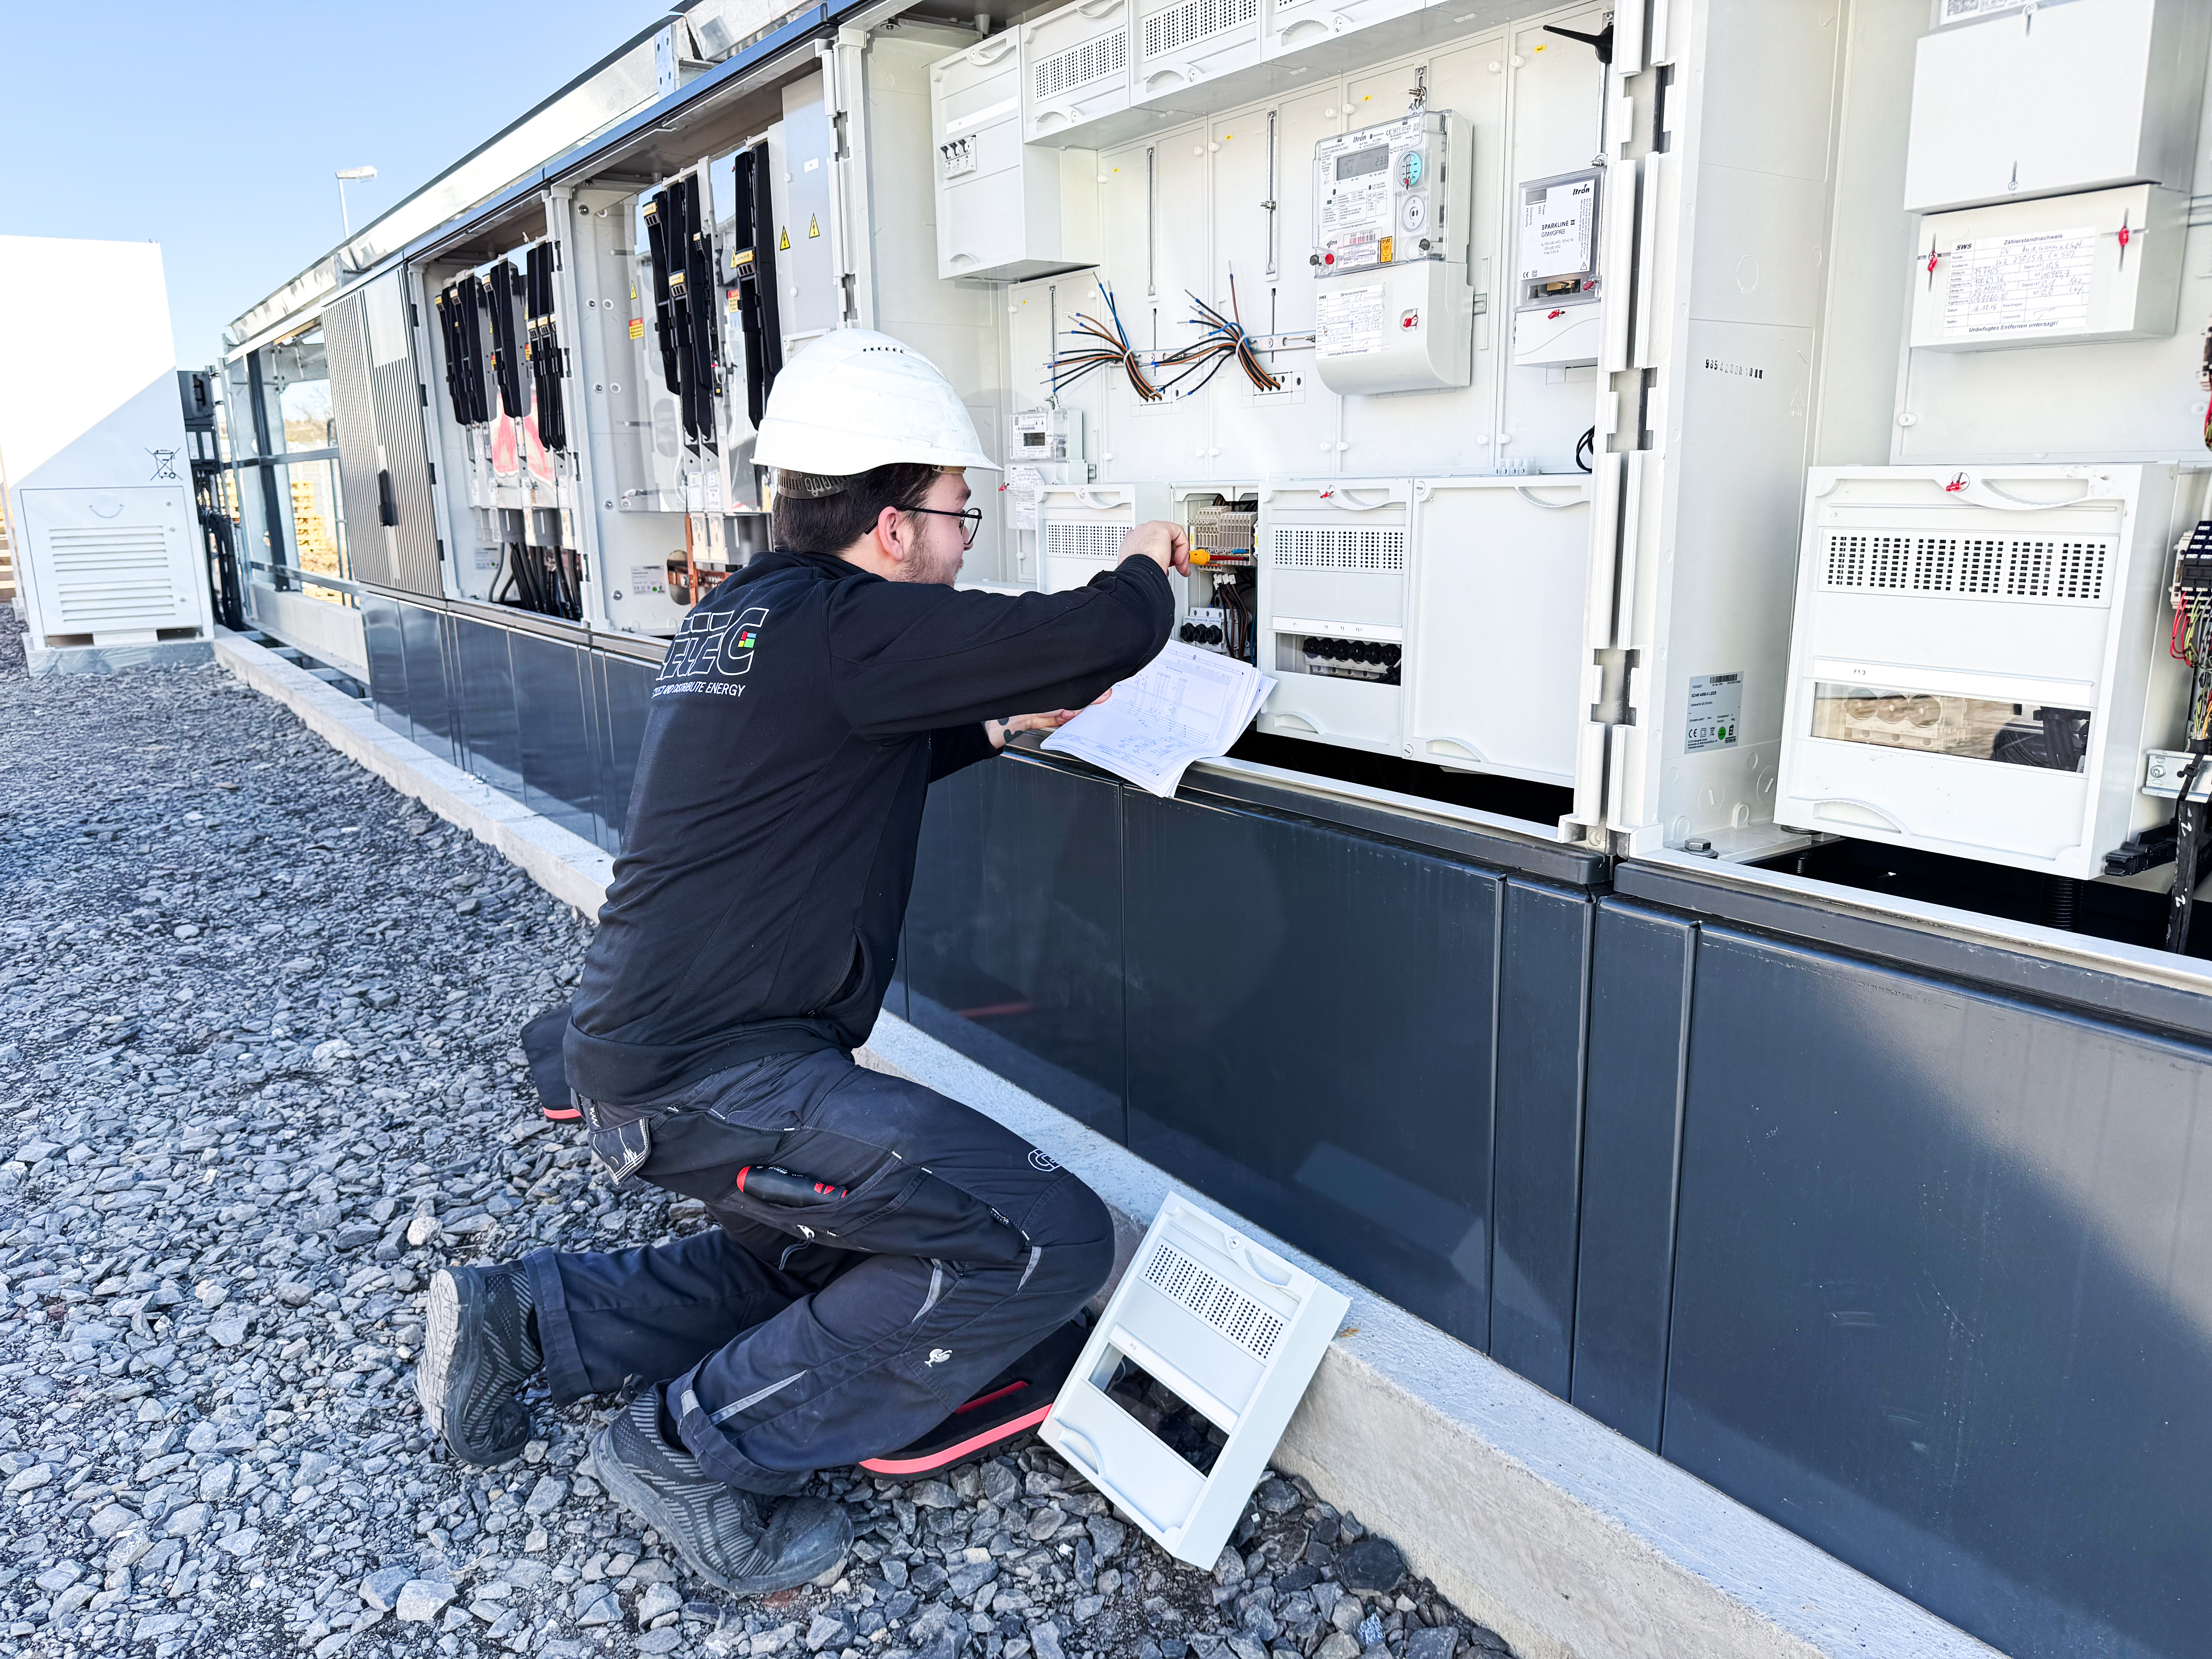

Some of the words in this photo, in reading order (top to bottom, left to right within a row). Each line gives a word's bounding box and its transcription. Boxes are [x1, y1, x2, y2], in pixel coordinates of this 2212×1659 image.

[1353, 132, 1367, 143] Itron
[1573, 184, 1590, 196] Itron
[1542, 220, 1569, 230] SPARKLINE
[2004, 233, 2063, 245] Zählerstandnachweis
[705, 682, 746, 697] ENERGY
